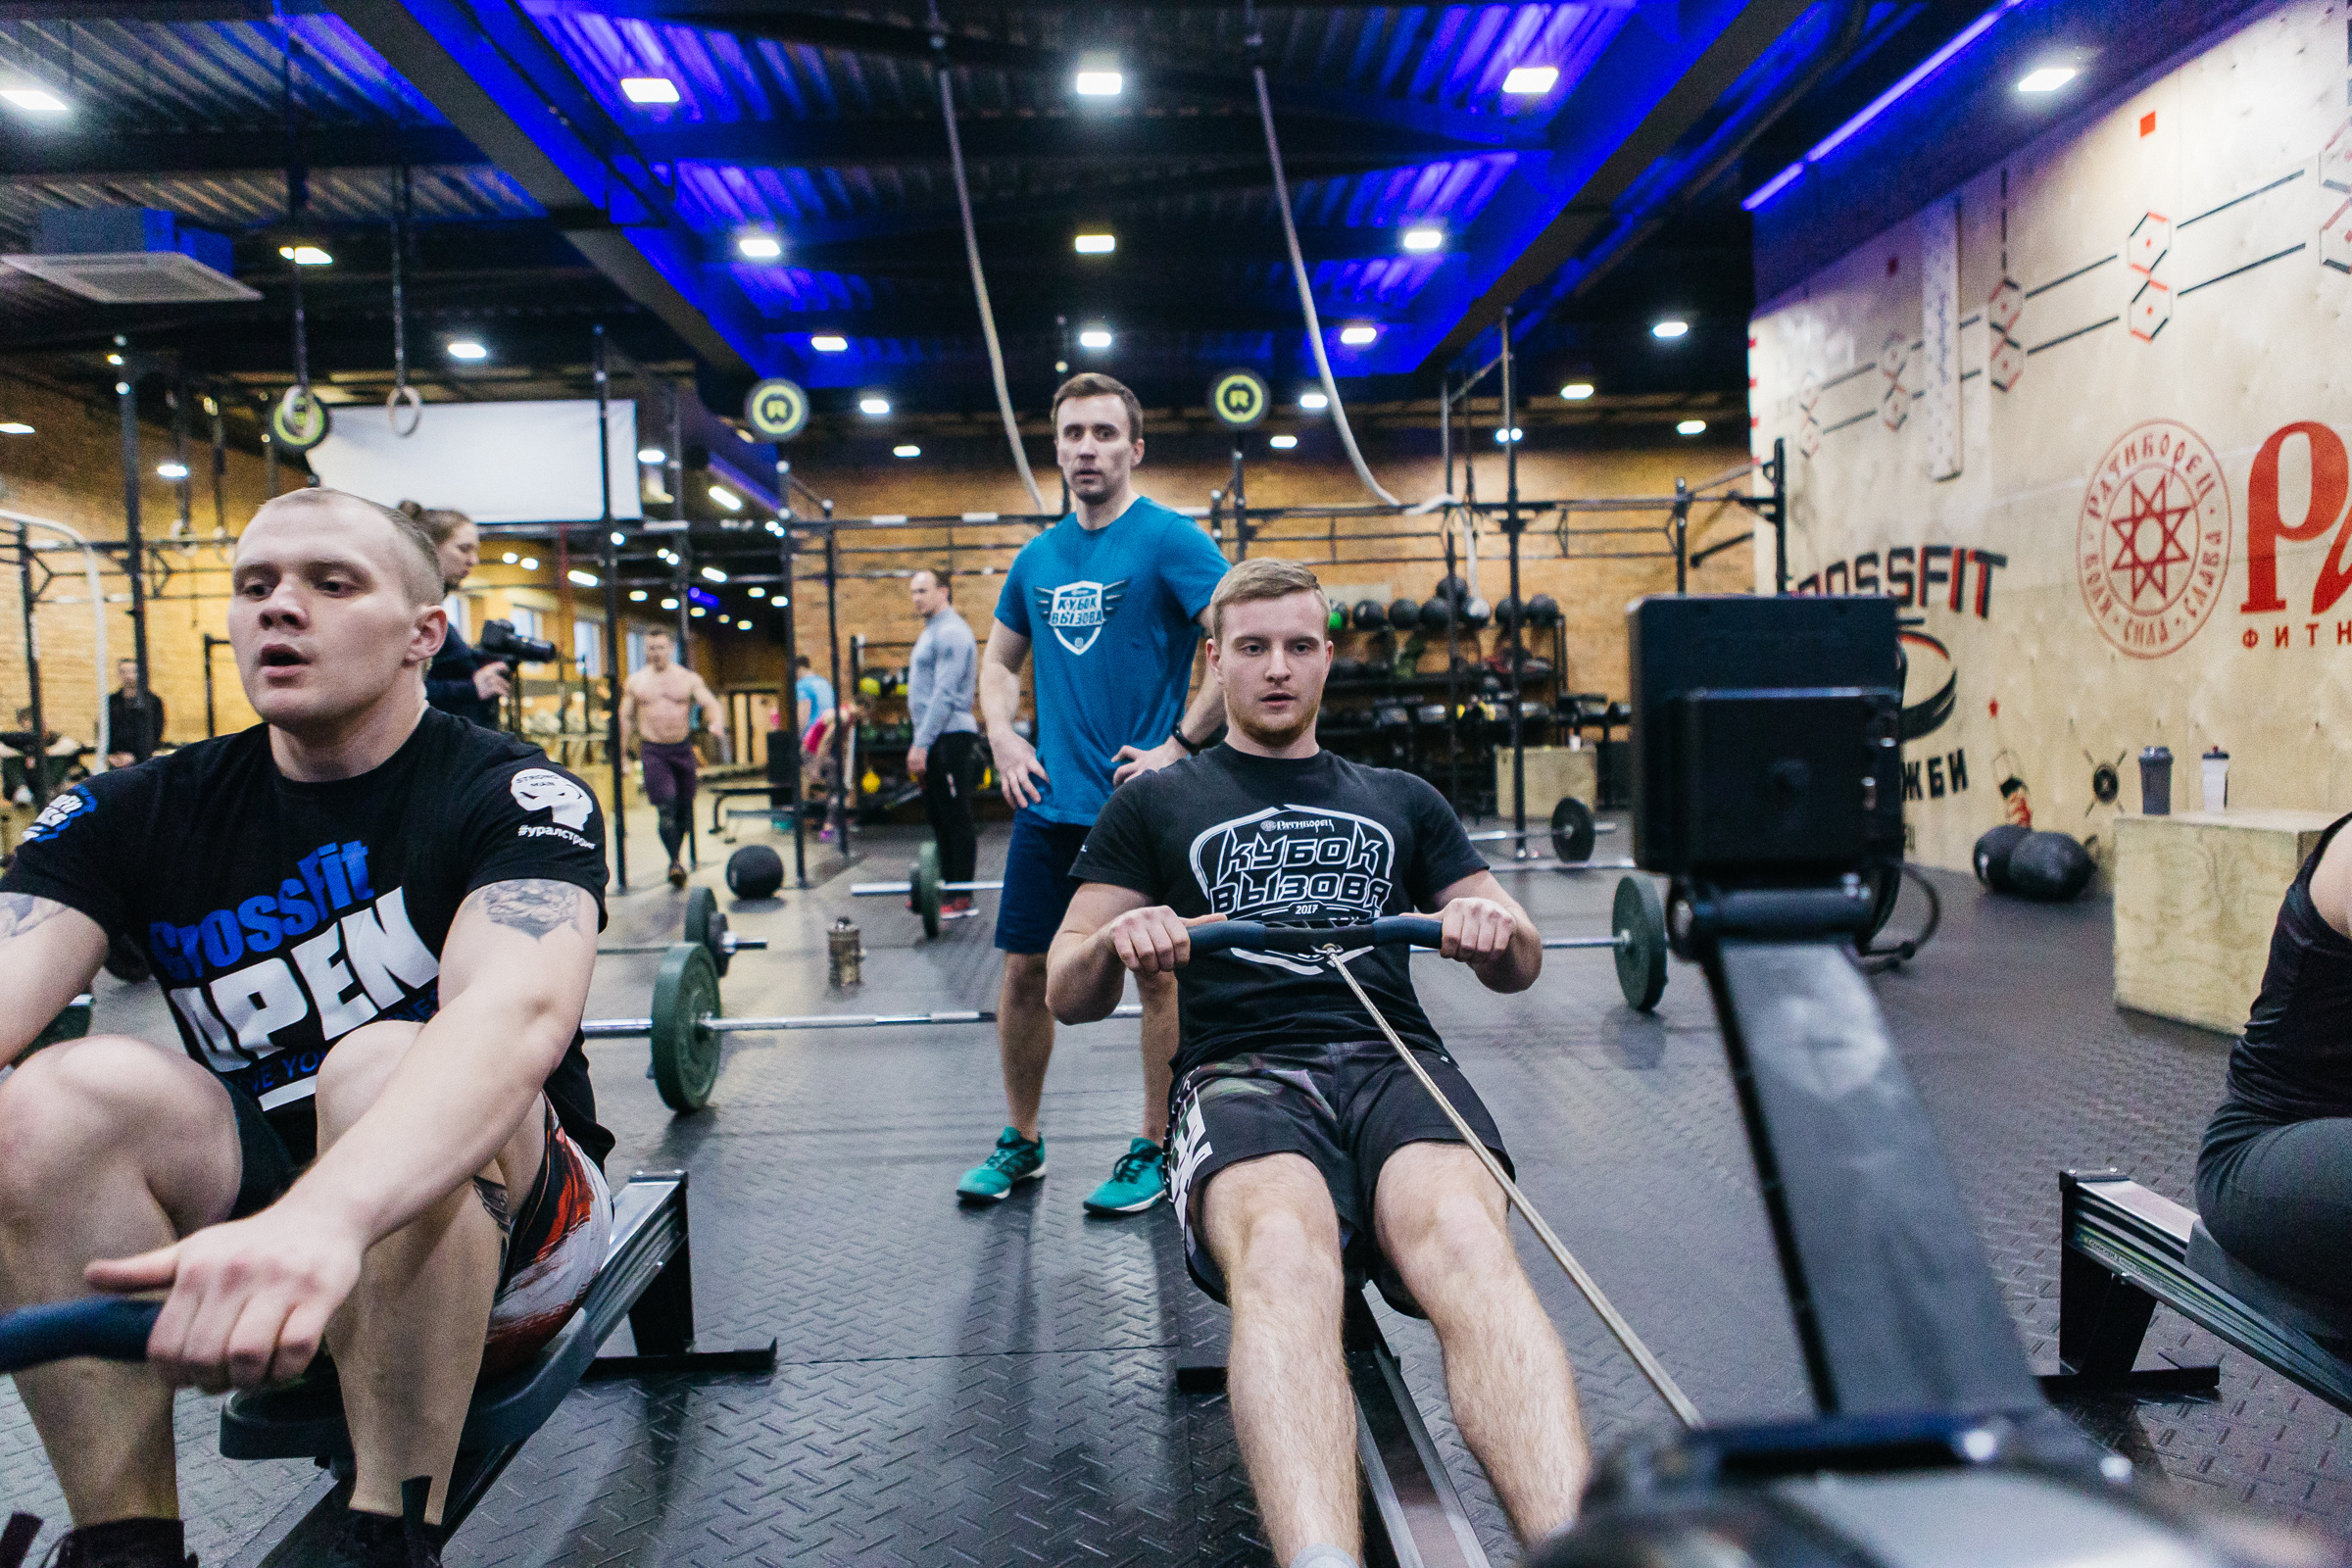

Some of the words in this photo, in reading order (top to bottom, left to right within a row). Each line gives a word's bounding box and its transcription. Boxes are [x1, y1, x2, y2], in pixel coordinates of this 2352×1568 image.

[1057, 596, 1097, 611] КУБОК
[1051, 610, 1102, 624] ВЫЗОВА
[1216, 820, 1384, 887] КУБОК
[1208, 867, 1393, 915] ВЫЗОВА
[1295, 904, 1319, 915] 2017
